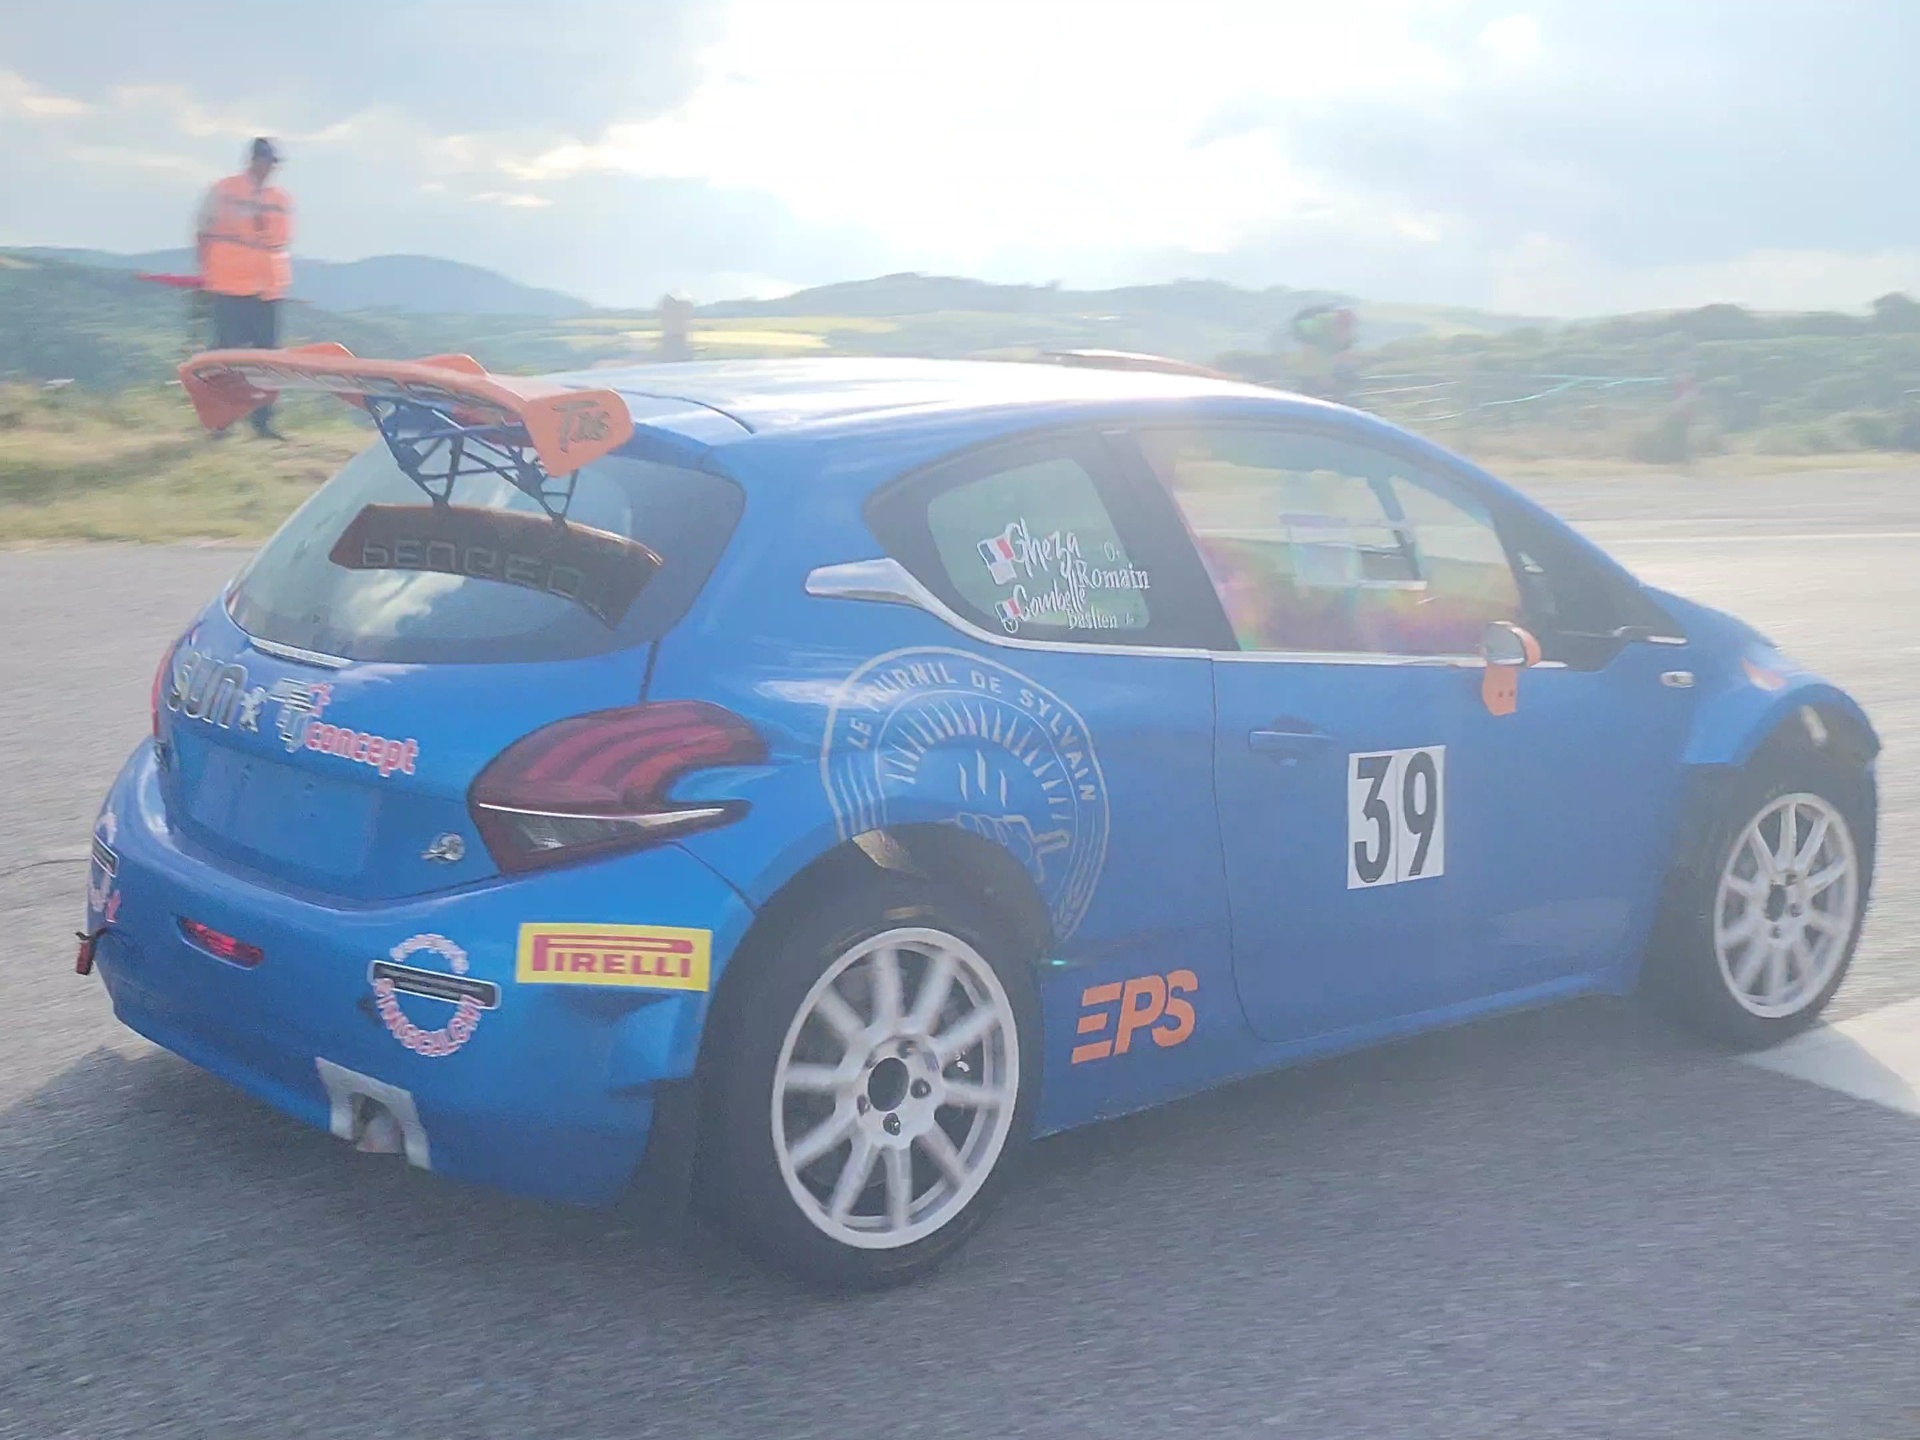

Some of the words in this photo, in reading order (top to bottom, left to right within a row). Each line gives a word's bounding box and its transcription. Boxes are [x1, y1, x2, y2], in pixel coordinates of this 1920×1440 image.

[1075, 558, 1151, 590] Romain
[306, 721, 420, 778] concept
[846, 716, 872, 751] LE
[970, 669, 1002, 694] DE
[1018, 687, 1097, 801] SYLVAIN
[1353, 751, 1439, 883] 39
[532, 934, 694, 978] PIRELLI
[1071, 969, 1199, 1064] EPS
